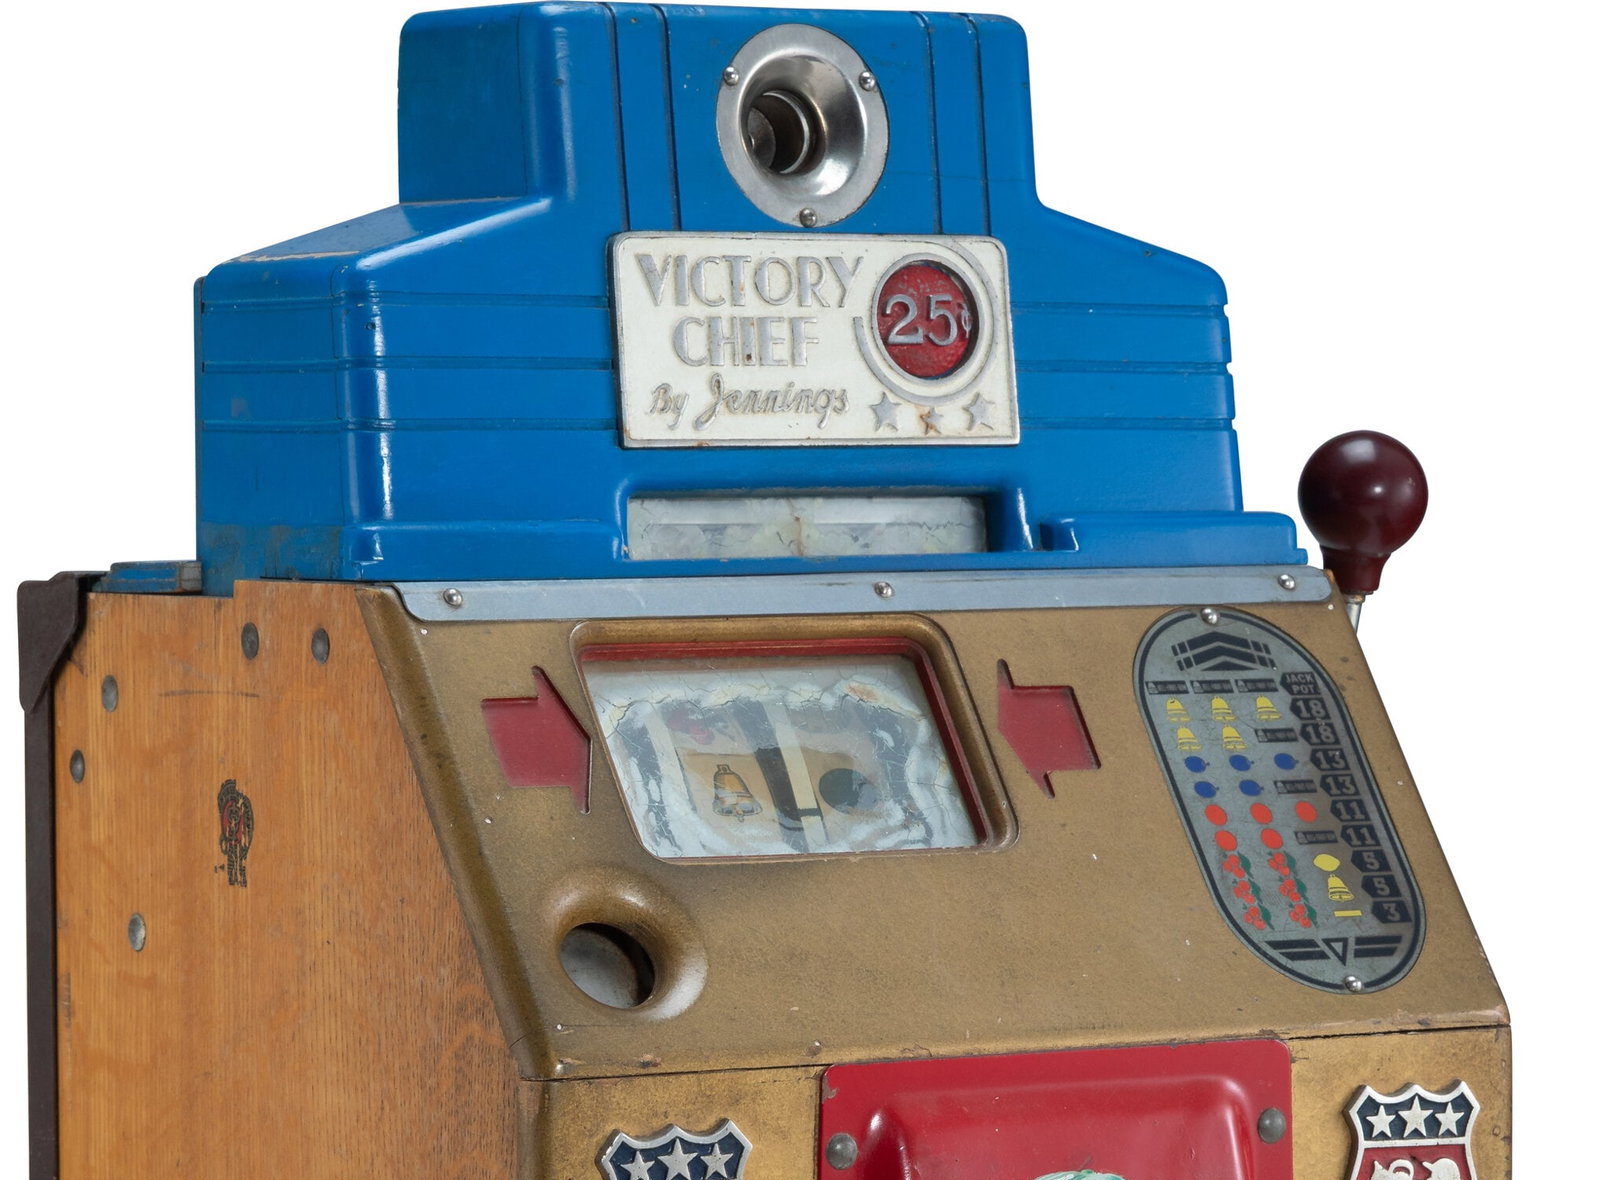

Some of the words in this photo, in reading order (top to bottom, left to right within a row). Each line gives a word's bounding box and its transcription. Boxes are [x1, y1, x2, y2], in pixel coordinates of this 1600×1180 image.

[636, 254, 864, 308] VICTORY
[673, 316, 820, 367] CHIEF
[648, 382, 689, 430] By
[693, 373, 850, 430] Jennings
[1285, 673, 1314, 684] JACK
[1291, 684, 1315, 694] POT
[1296, 700, 1327, 718] 18
[1306, 724, 1336, 744] 18
[1315, 750, 1346, 769] 13
[1326, 776, 1356, 795] 13
[1335, 801, 1366, 819] 11
[1346, 827, 1377, 846] 11
[1362, 852, 1380, 870] 5
[1372, 877, 1391, 896] 5
[1382, 903, 1401, 921] 3
